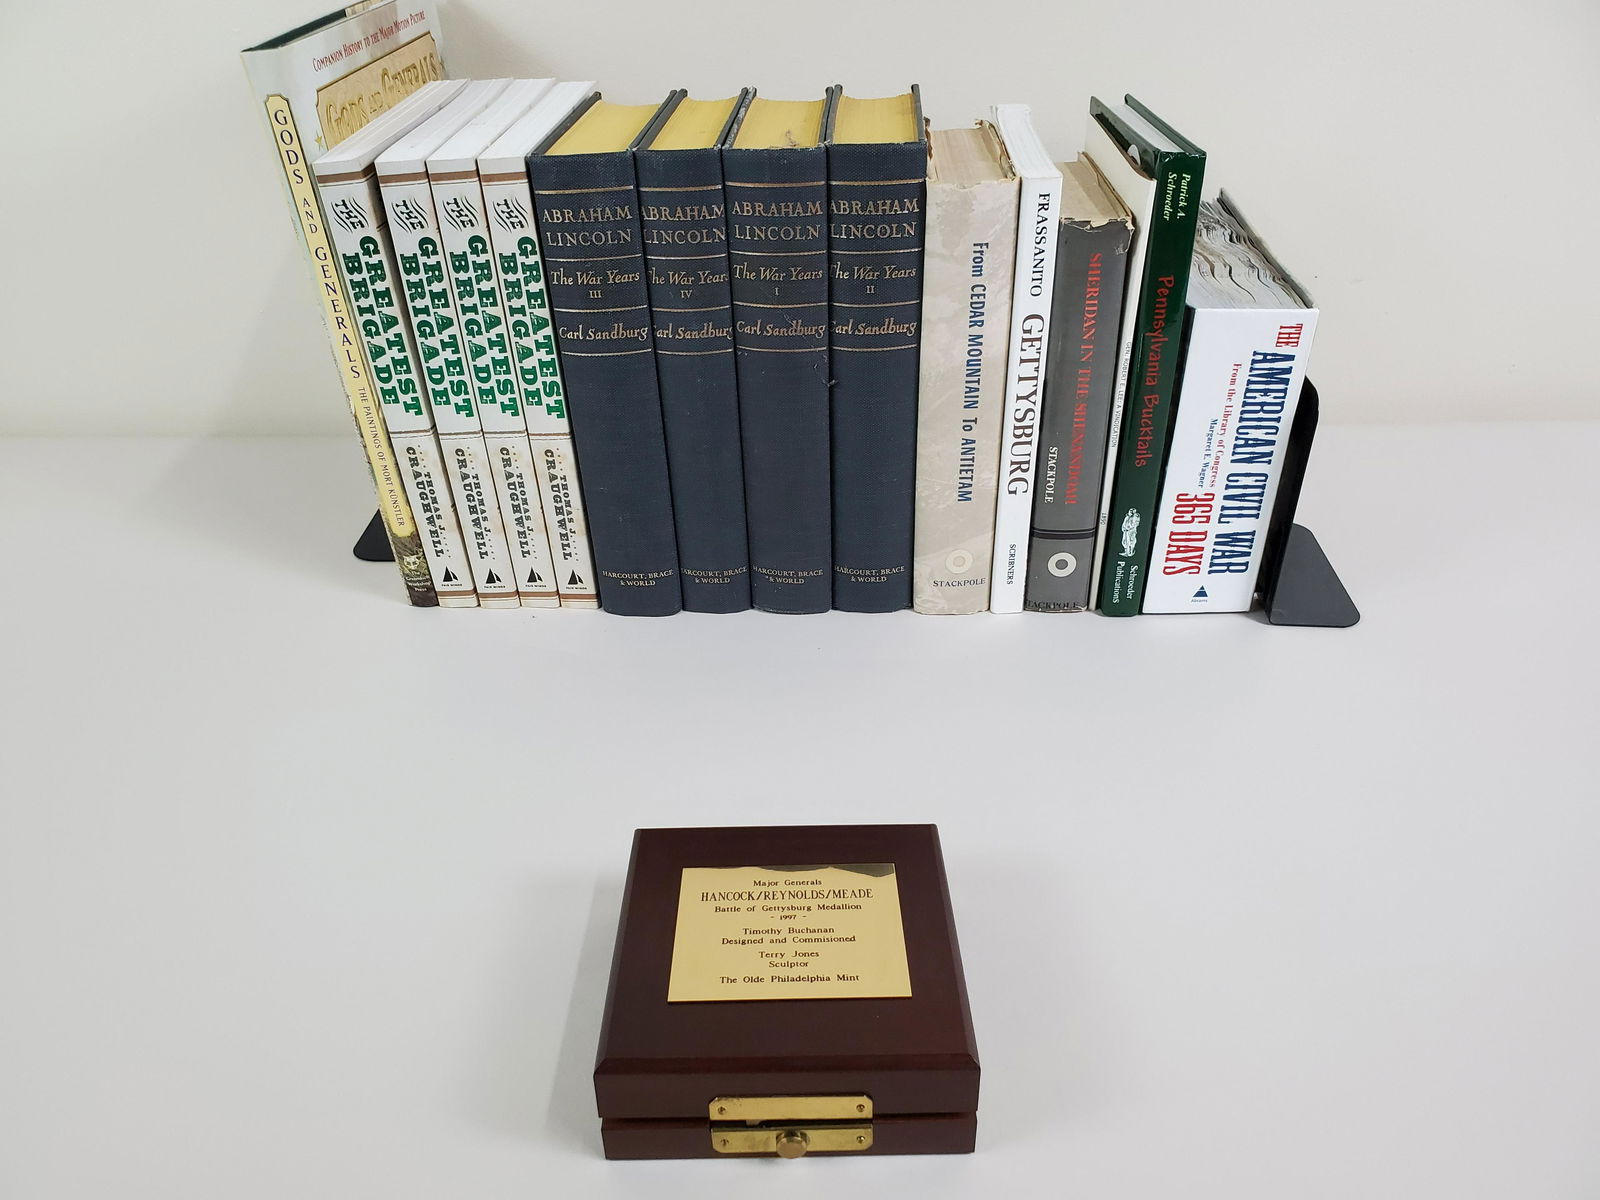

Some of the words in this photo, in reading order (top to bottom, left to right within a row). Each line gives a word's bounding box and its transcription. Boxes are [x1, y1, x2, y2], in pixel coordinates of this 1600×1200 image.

[312, 50, 344, 72] COMPANION
[342, 39, 364, 59] HISTORY
[363, 36, 370, 46] TO
[370, 32, 380, 44] THE
[379, 24, 394, 40] MAJOR
[394, 18, 410, 34] MOTION
[409, 10, 426, 26] PICTURE
[274, 109, 304, 185] GODS
[1162, 172, 1178, 221] Schroeder
[1179, 173, 1191, 208] Patrick
[303, 196, 318, 234] AND
[334, 200, 365, 230] THE
[396, 200, 424, 230] THE
[446, 198, 474, 230] THE
[497, 200, 525, 231] THE
[542, 206, 633, 224] ABRAHAM
[732, 200, 824, 218] ABRAHAM
[830, 198, 920, 216] ABRAHAM
[1176, 208, 1186, 220] A.
[546, 228, 632, 246] LINCOLN
[734, 224, 820, 241] LINCOLN
[830, 222, 917, 240] LINCOLN
[1030, 192, 1050, 297] FRASSANITO
[732, 262, 756, 280] The
[759, 266, 786, 281] War
[789, 266, 823, 281] Years
[852, 266, 880, 280] War
[883, 266, 916, 280] Years
[972, 242, 988, 278] From
[550, 267, 574, 286] The
[576, 271, 602, 286] War
[606, 269, 640, 284] Years
[668, 271, 695, 285] War
[774, 286, 780, 296] I
[866, 285, 876, 294] II
[588, 290, 602, 298] III
[680, 290, 692, 299] IV
[968, 284, 987, 328] CEDAR
[1082, 252, 1102, 341] SHERIDAN
[314, 246, 360, 379] GENERALS
[359, 236, 424, 416] GREATEST
[418, 236, 474, 418] GREATEST
[468, 235, 520, 416] GREATEST
[517, 236, 565, 418] GREATEST
[854, 318, 918, 336] Sandburg
[342, 252, 400, 405] BRIGADE
[400, 253, 451, 406] BRIGADE
[450, 252, 498, 405] BRIGADE
[498, 252, 542, 406] BRIGADE
[559, 324, 584, 340] Carl
[586, 322, 648, 342] Sandburg
[654, 322, 673, 338] arl
[736, 320, 762, 336] Carl
[763, 320, 826, 338] Sandburg
[1145, 274, 1175, 386] Pennsylvania
[1276, 324, 1303, 347] THE
[1080, 344, 1094, 363] IN
[963, 334, 984, 409] MOUNTAIN
[1075, 368, 1092, 399] THE
[1120, 358, 1128, 381] ROBERT
[1230, 364, 1242, 386] From
[358, 387, 368, 402] THE
[1008, 314, 1045, 496] GETTYSBURG
[1227, 389, 1236, 402] the
[1230, 351, 1296, 464] AMERICAN
[364, 406, 382, 448] PAINTINGS
[962, 416, 978, 432] To
[1112, 410, 1120, 448] VINDICATION
[1135, 394, 1160, 467] Bucktails
[1205, 418, 1218, 452] Margaret
[1218, 405, 1234, 436] Library
[377, 452, 386, 461] OF
[1064, 402, 1088, 506] SHENANDOAH
[1217, 439, 1226, 449] of
[380, 465, 393, 486] MORT
[958, 438, 976, 502] ANTIETAM
[1044, 446, 1058, 504] STACKPOLE
[1198, 462, 1210, 488] Wagner
[1210, 450, 1224, 488] Congress
[406, 446, 444, 558] CRAUGHWELL
[424, 472, 442, 520] THOMAS
[454, 448, 488, 560] CRAUGHWELL
[472, 474, 488, 522] THOMAS
[500, 447, 530, 558] CRAUGHWELL
[516, 473, 532, 522] THOMAS
[544, 449, 572, 560] CRAUGHWELL
[560, 475, 574, 523] THOMAS
[1172, 493, 1215, 524] 365
[1218, 472, 1269, 524] CIVIL
[1006, 544, 1016, 585] SCRIBNERS
[1163, 530, 1208, 576] DAYS
[1208, 530, 1256, 574] WAR
[648, 569, 674, 579] BRACE
[752, 564, 797, 578] HARCOURT,
[799, 568, 824, 577] BRACE
[880, 566, 905, 576] BRACE
[932, 577, 986, 588] STACKPOLE
[1112, 561, 1126, 604] Publications
[1126, 565, 1138, 600] Schroeder
[701, 888, 874, 902] HANCOCK/REYNOLDS/MEADE
[762, 904, 812, 912] Gettysburg
[818, 902, 862, 910] Medallion
[722, 937, 764, 946] Designed
[792, 936, 856, 944] Commisioned
[743, 927, 782, 936] Timothy
[758, 951, 785, 960] Terry
[769, 960, 809, 968] Sculptor
[771, 975, 830, 984] Philadelphia
